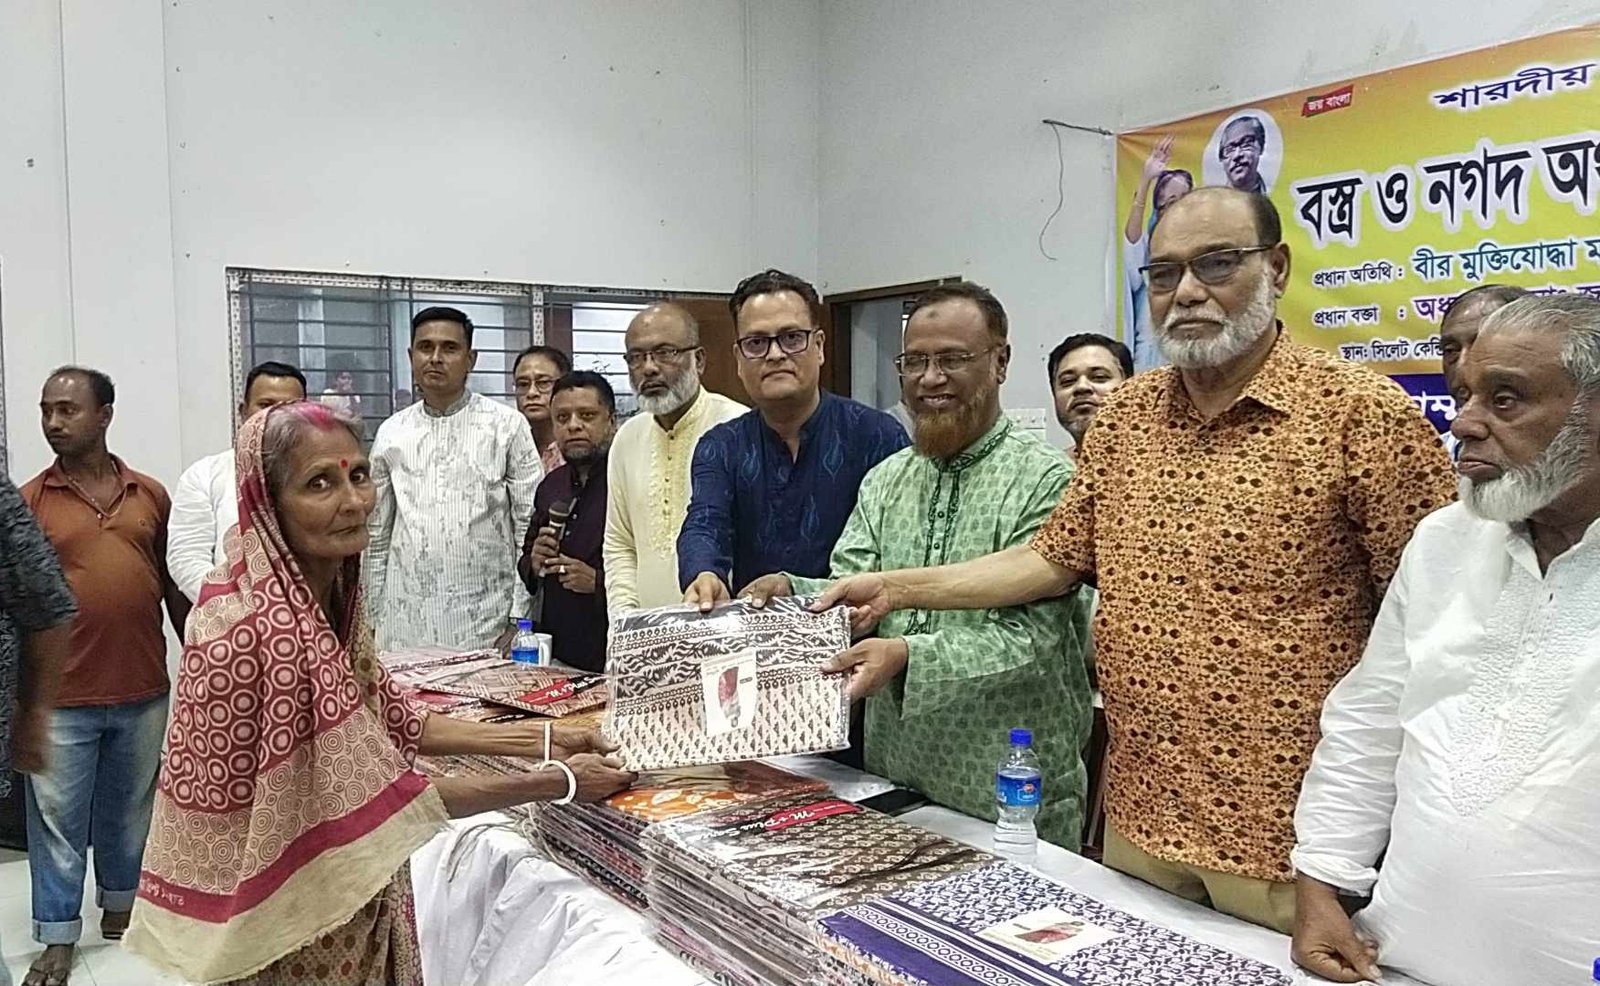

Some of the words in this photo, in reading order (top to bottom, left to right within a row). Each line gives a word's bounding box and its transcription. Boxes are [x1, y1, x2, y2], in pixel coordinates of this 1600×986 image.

[1434, 63, 1597, 108] শারদীয়
[1296, 177, 1363, 241] বস্ত্র
[1376, 172, 1408, 224] ও
[1423, 147, 1532, 225] নগদ
[1314, 270, 1346, 286] প্রধান
[1349, 261, 1393, 282] অতিথি
[1413, 247, 1453, 280] বীর
[1460, 238, 1577, 281] মুক্তিযোদ্ধা
[1314, 310, 1347, 326] প্রধান
[1350, 306, 1378, 322] বক্তা
[1371, 339, 1410, 359] সিলেট
